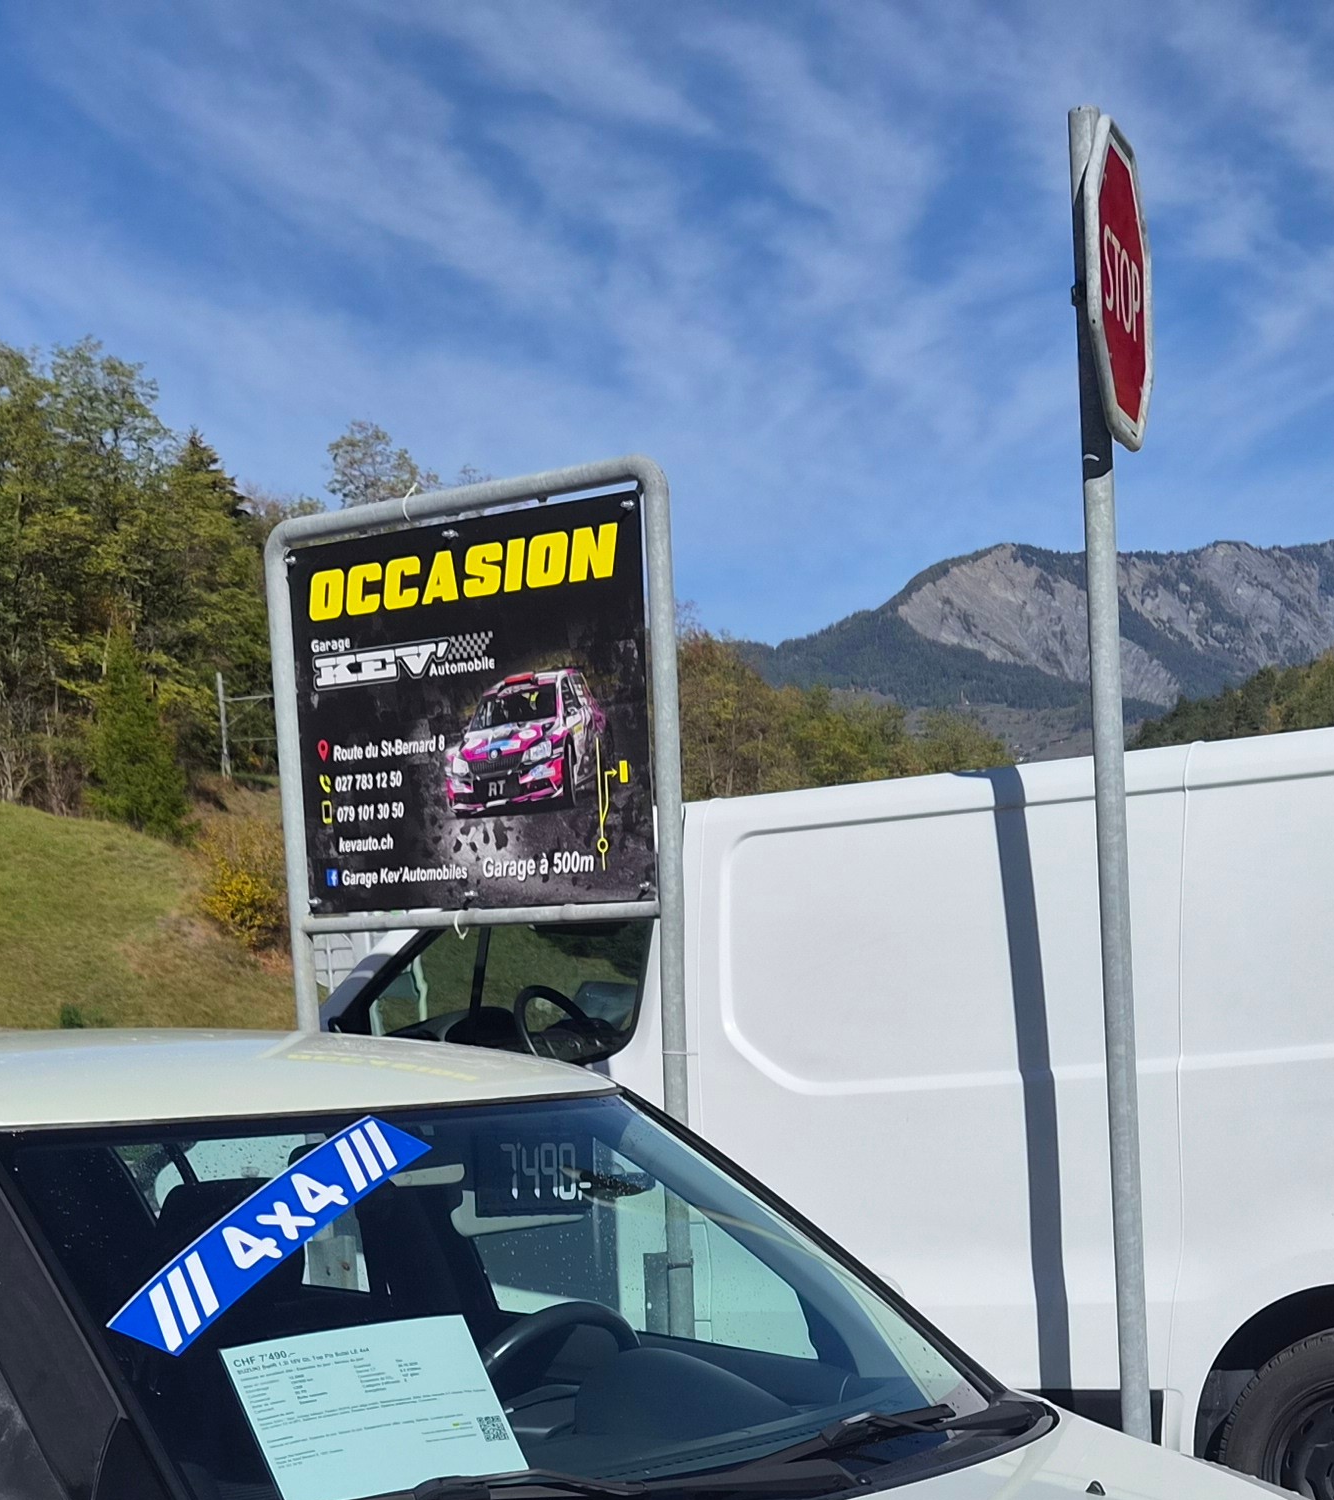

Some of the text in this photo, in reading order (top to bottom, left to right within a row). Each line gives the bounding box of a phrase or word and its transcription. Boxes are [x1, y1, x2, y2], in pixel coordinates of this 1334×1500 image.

[1104, 223, 1140, 342] STOP
[309, 522, 618, 622] OCCASION
[311, 637, 351, 653] Garage
[429, 656, 496, 677] Automobile
[333, 734, 446, 762] Route du St-Bernard 8
[335, 770, 402, 792] 027 783 12 50
[337, 801, 404, 823] 079 101 30 50
[339, 833, 394, 853] kevauto.ch
[482, 852, 595, 881] Garage à 500m
[342, 868, 379, 888] Garage
[222, 1173, 349, 1269] 4x4
[233, 1356, 256, 1368] CHF
